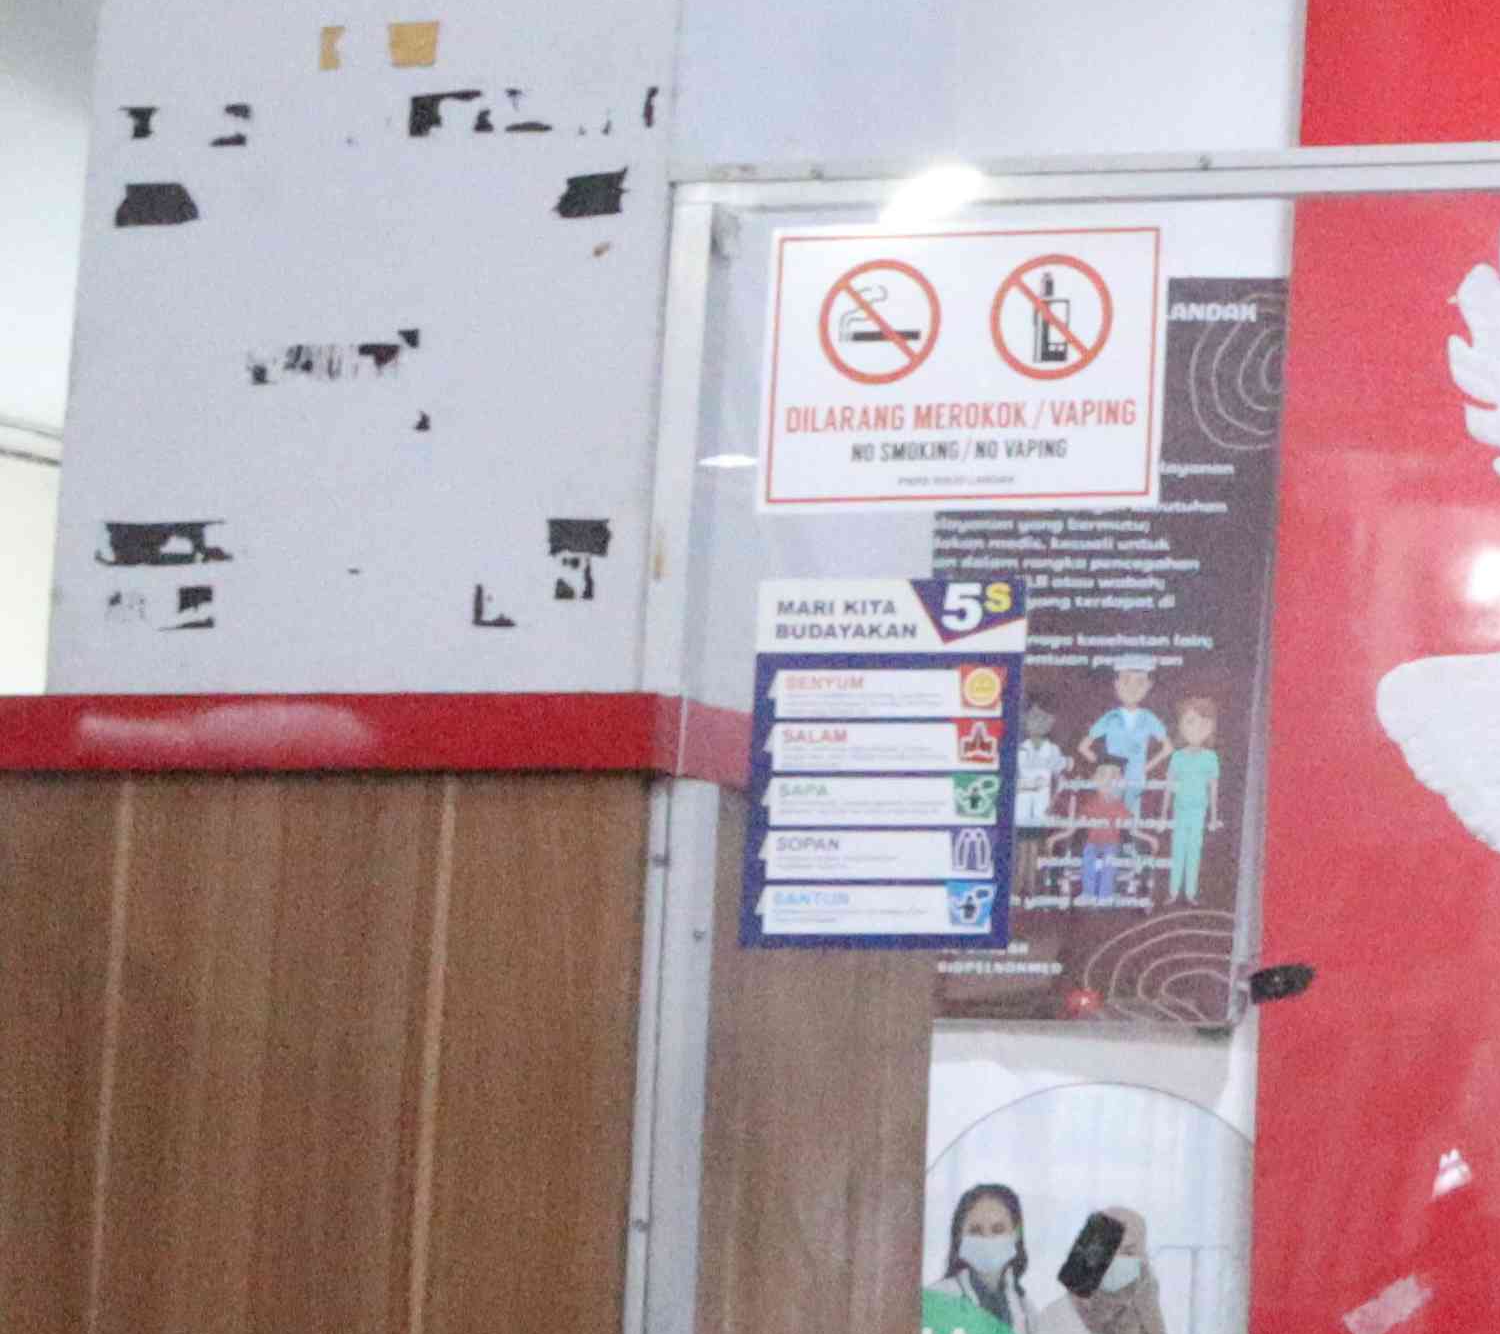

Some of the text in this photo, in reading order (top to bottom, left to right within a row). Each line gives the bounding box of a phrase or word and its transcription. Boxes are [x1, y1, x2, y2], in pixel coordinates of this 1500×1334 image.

[785, 404, 905, 434] DILARANG
[914, 401, 1026, 430] MEROKOK
[1051, 398, 1137, 426] VAPING
[851, 444, 874, 462] NO
[880, 442, 960, 461] SMOKING
[975, 441, 998, 460] NO
[1005, 438, 1068, 459] VAPING
[777, 600, 896, 616] MARI KITA
[775, 623, 918, 640] BUDAYAKAN
[784, 675, 865, 691] SENYUM
[783, 728, 849, 744] SALAM
[779, 782, 829, 798] SAPA
[775, 836, 840, 853] SOPAN
[773, 891, 850, 907] SANTUN
